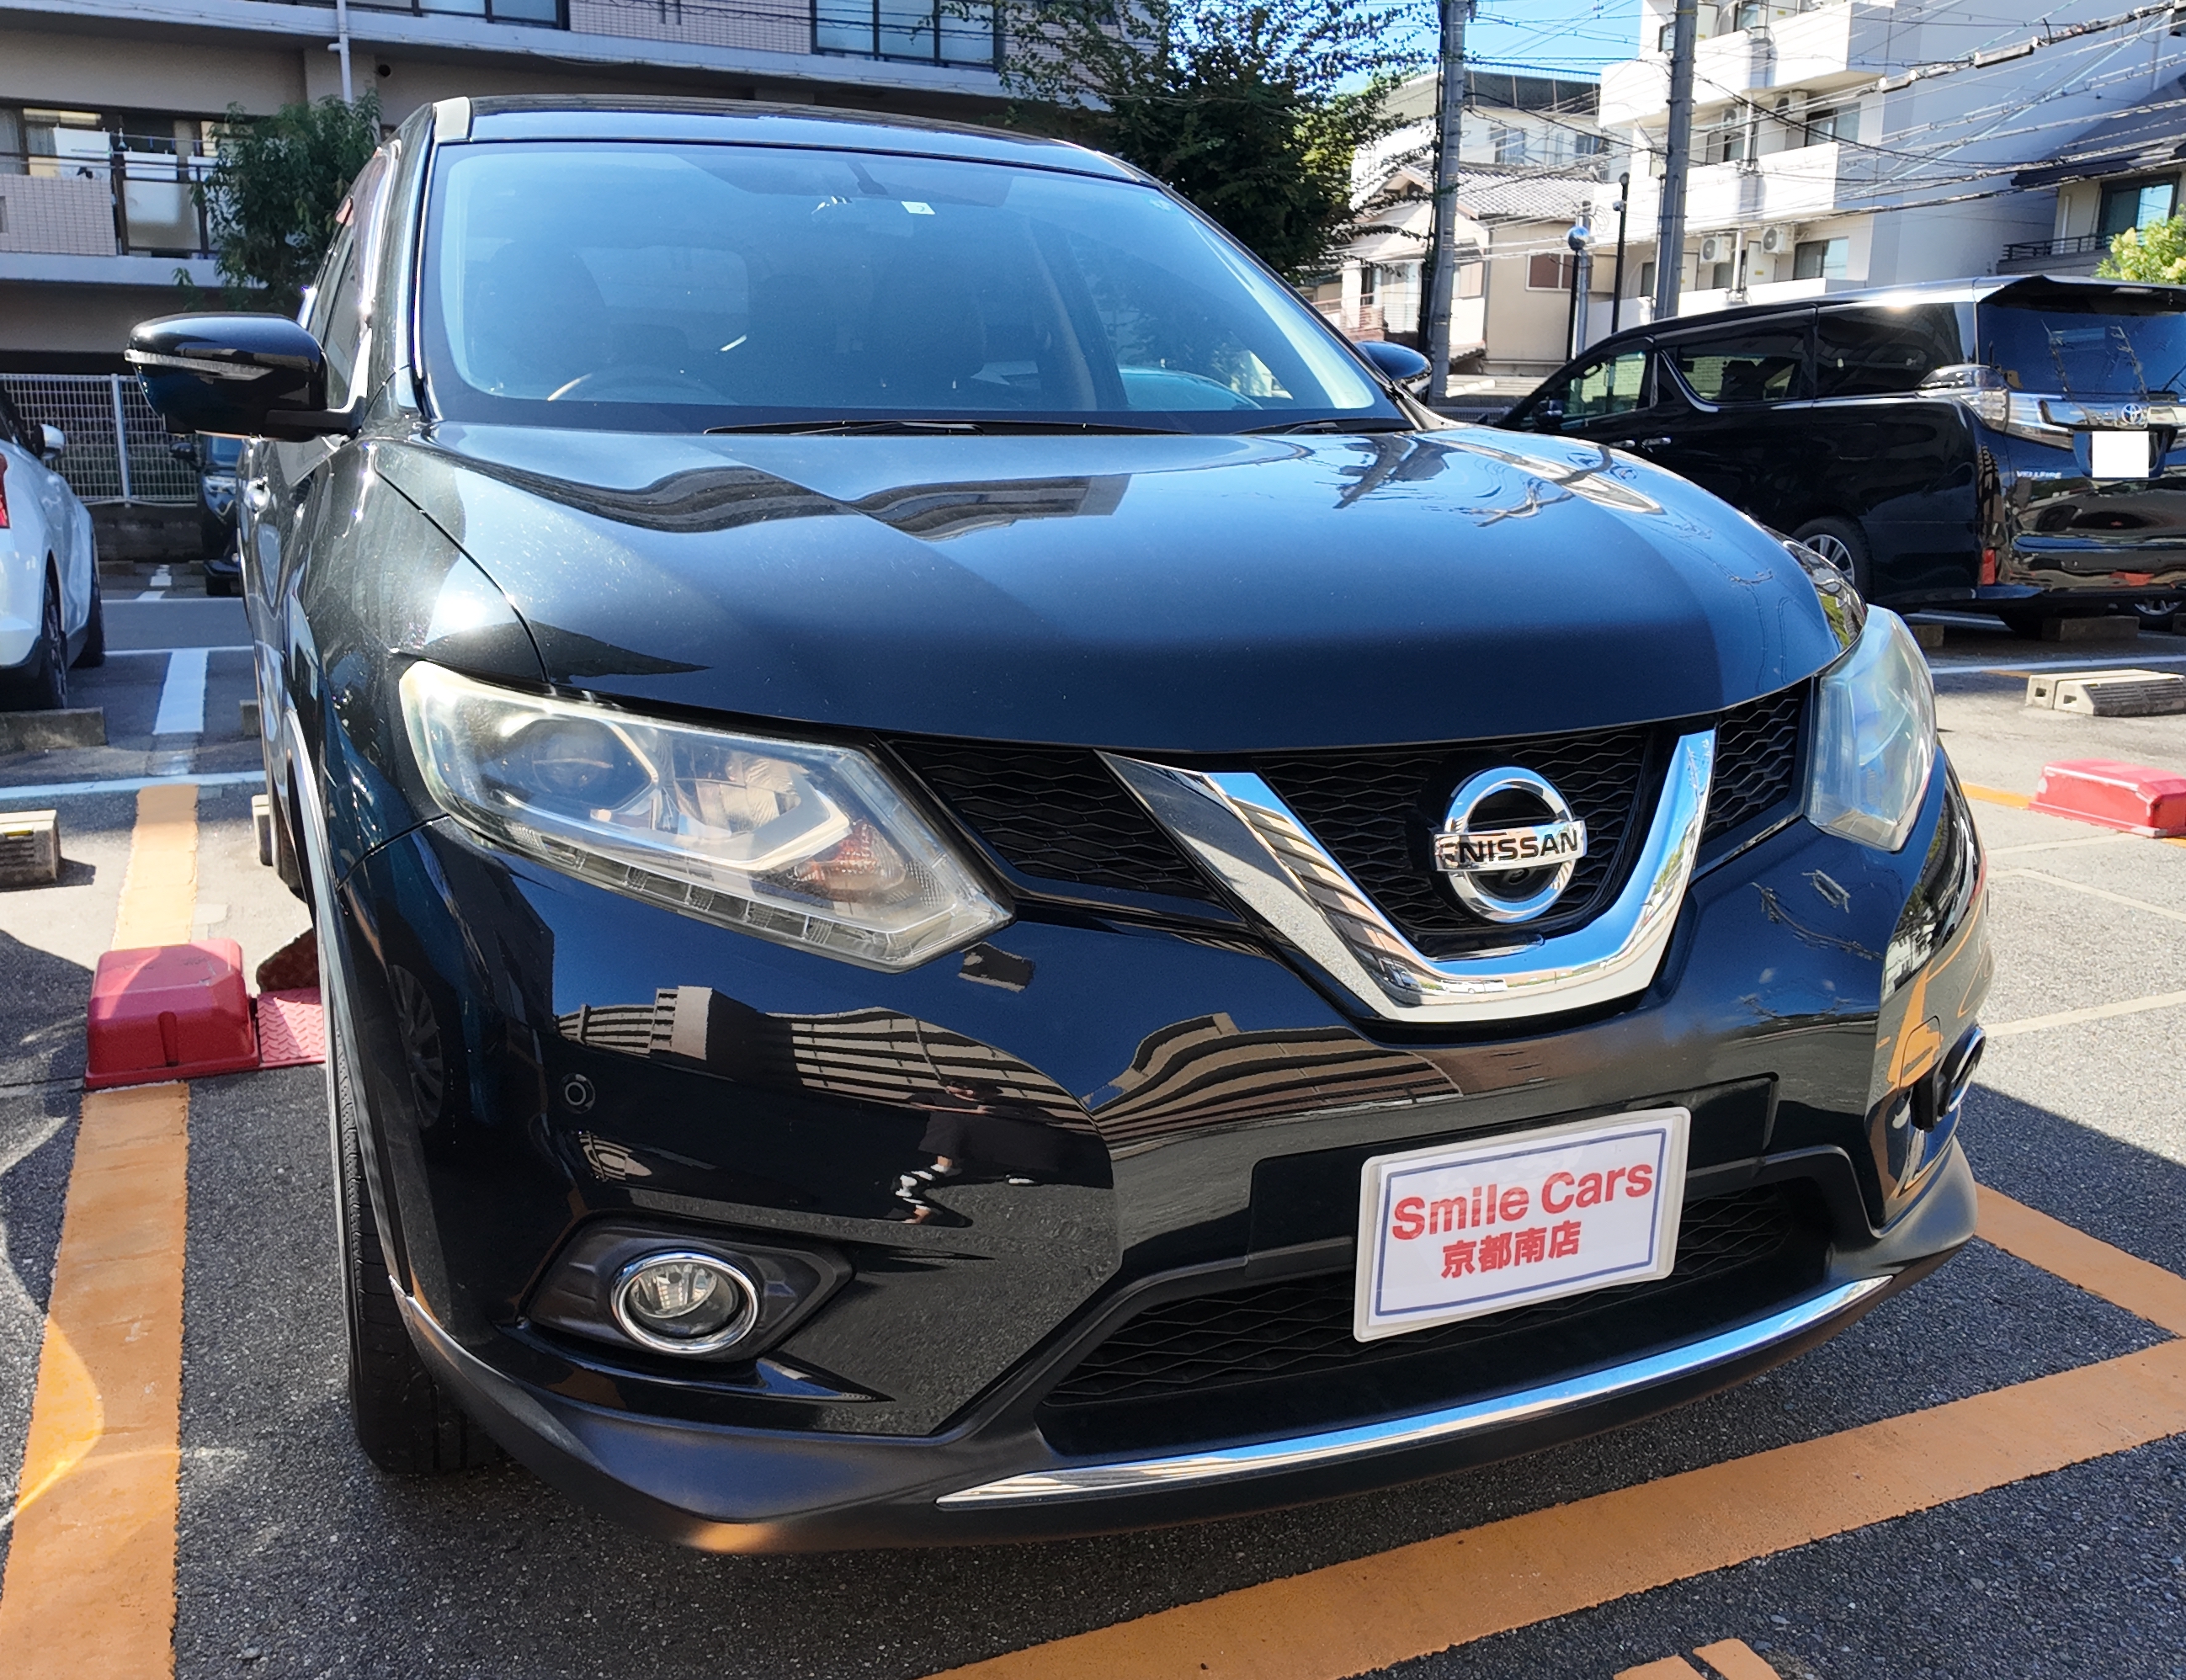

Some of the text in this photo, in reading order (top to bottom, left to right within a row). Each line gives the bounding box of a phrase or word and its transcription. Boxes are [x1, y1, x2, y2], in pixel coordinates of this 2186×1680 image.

[1459, 829, 1578, 863] NISSAN
[1392, 1163, 1653, 1241] Smile Cars
[1441, 1220, 1582, 1279] 京都南店
